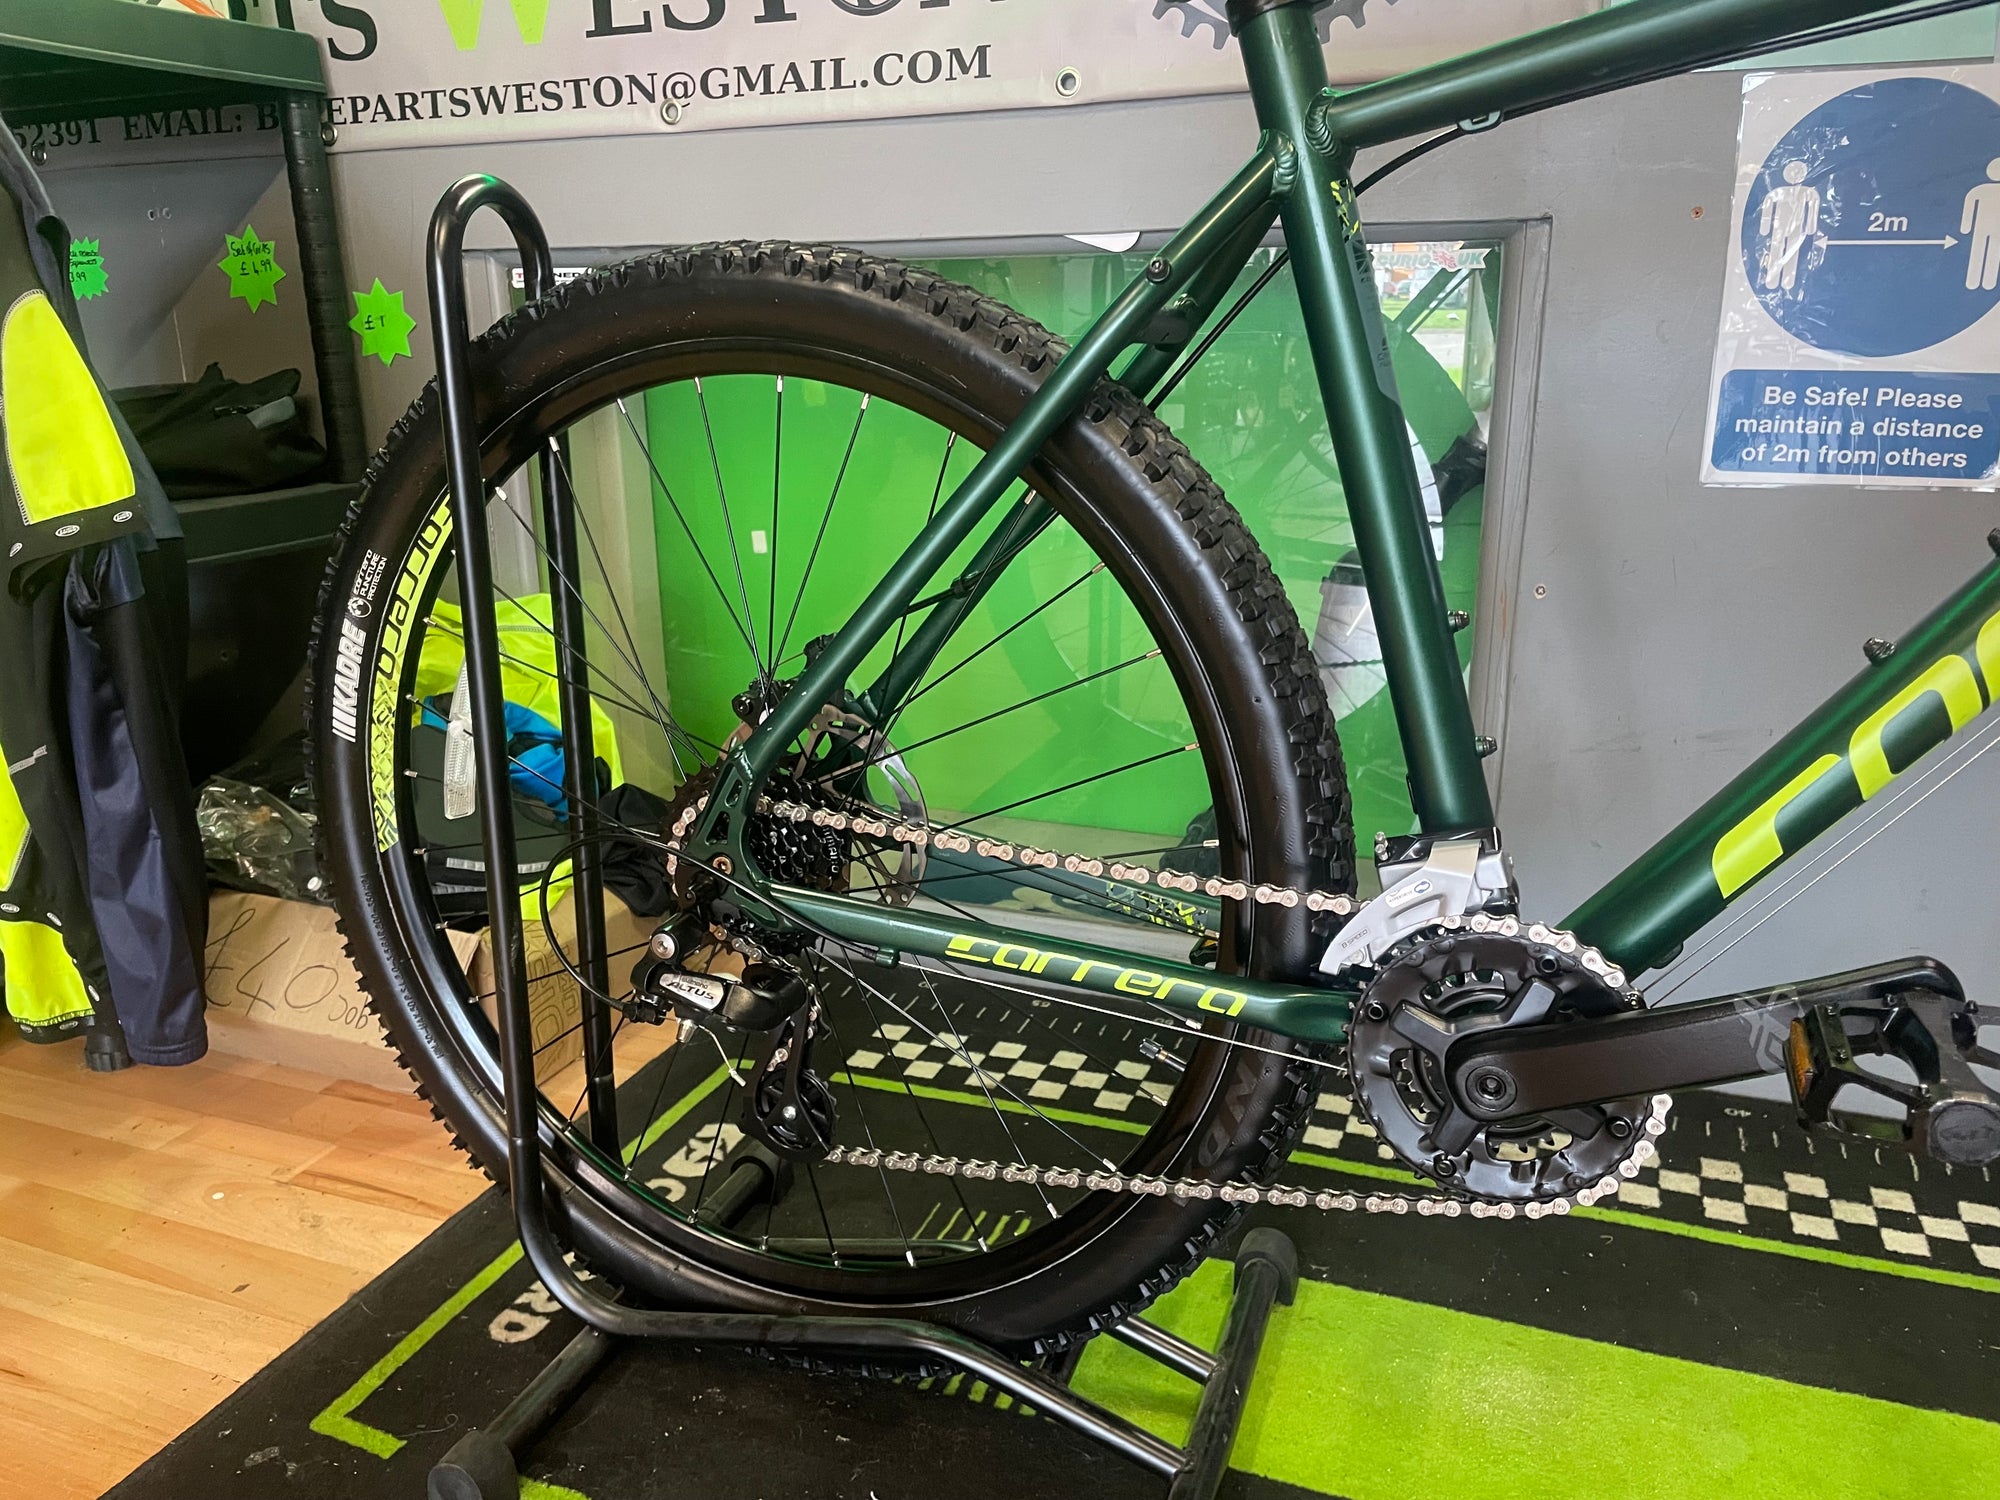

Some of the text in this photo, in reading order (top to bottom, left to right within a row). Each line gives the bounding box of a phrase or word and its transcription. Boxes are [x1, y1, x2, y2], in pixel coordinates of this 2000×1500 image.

[256, 44, 991, 131] BEPARTSWESTON@GMAIL.COM
[1867, 213, 1909, 233] 2m
[1457, 252, 1484, 265] UK
[1764, 385, 1963, 409] Be Safe! Please
[1735, 415, 1984, 439] maintain a distance
[1741, 443, 1968, 468] of 2m from others
[359, 552, 381, 596] PUNCTURE
[366, 556, 388, 601] PROTECTION
[944, 934, 1248, 1018] carrera
[666, 981, 715, 1001] ALTUS
